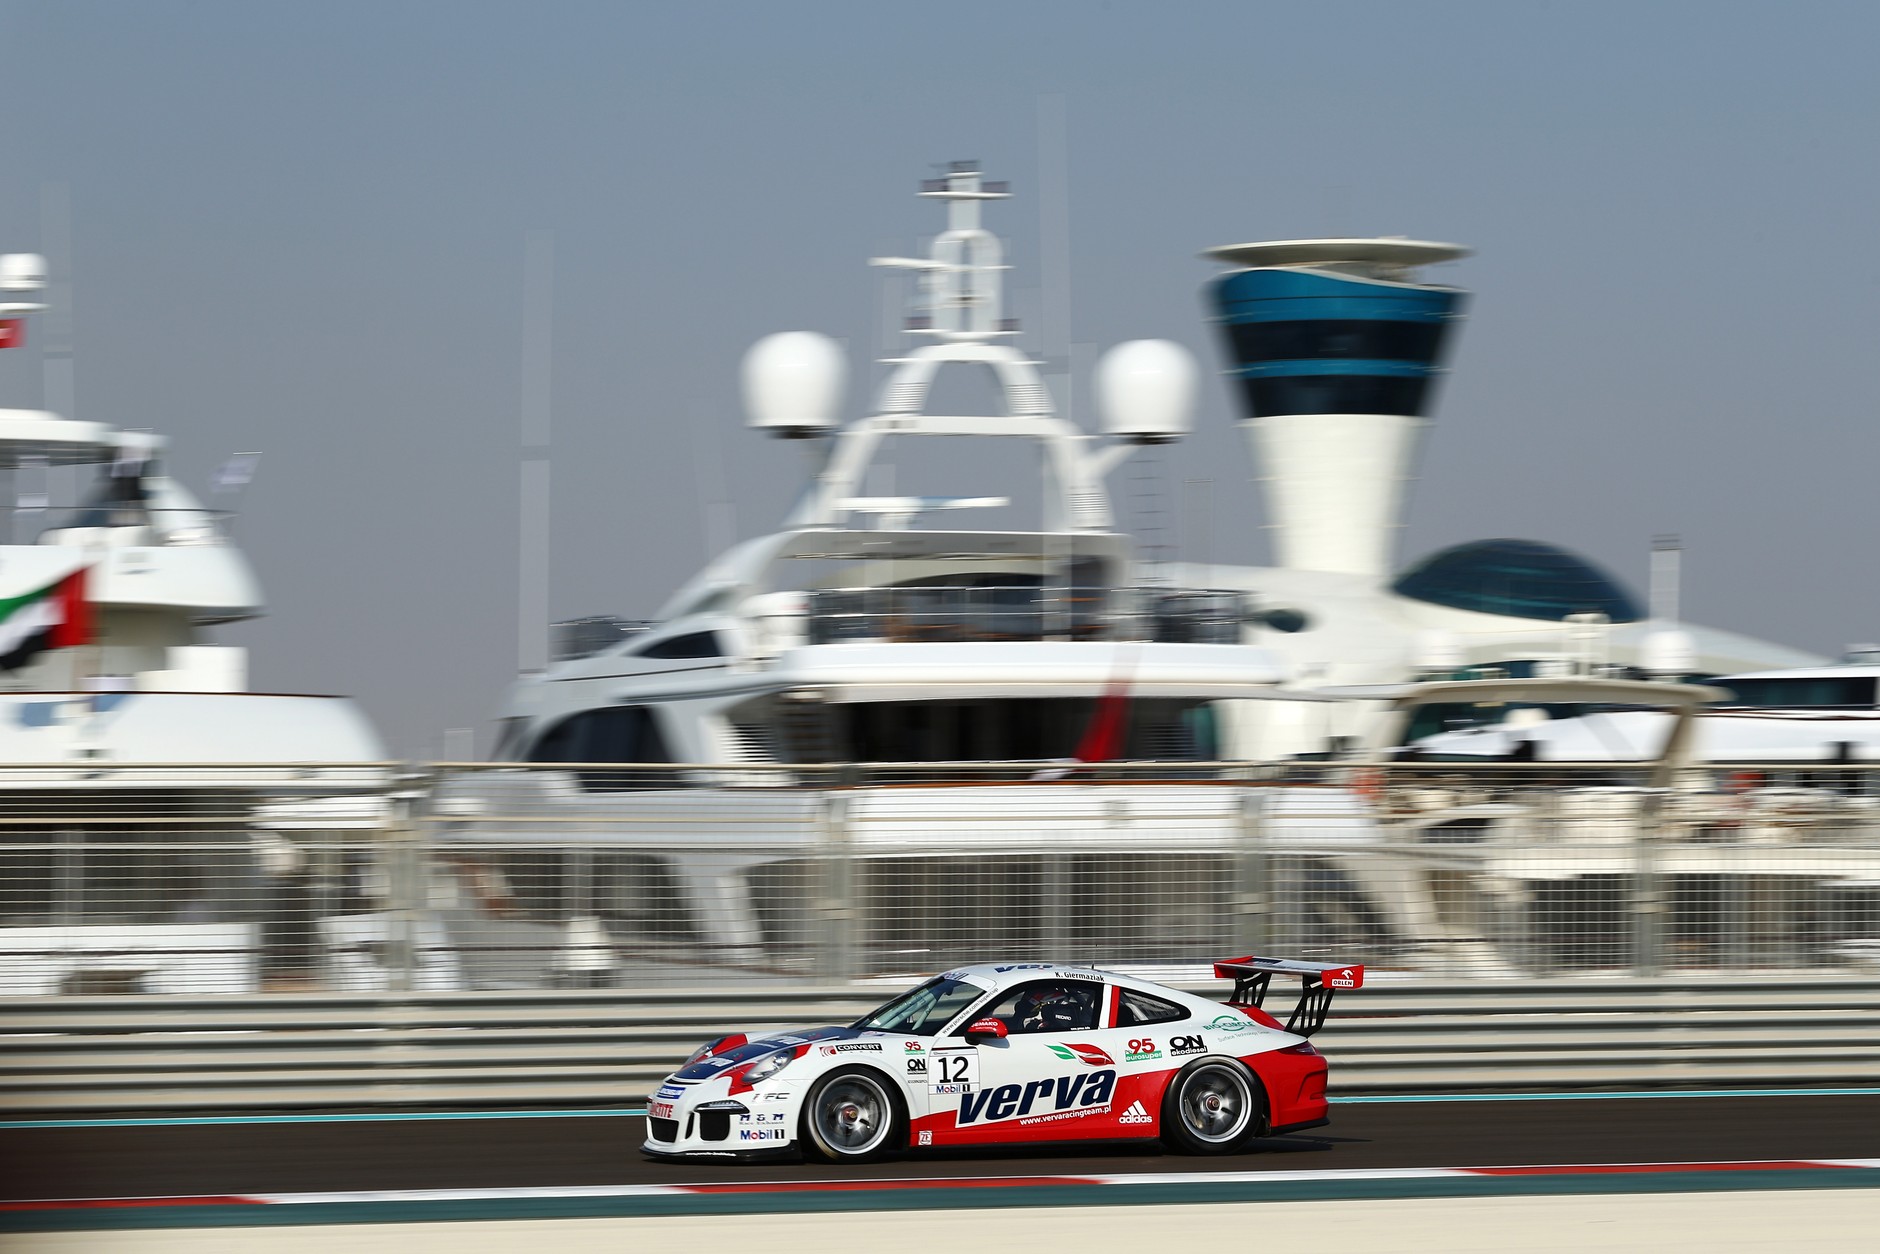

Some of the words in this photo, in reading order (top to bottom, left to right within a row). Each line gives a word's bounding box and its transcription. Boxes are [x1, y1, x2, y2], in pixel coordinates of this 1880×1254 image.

[1064, 972, 1105, 982] Giermaziak
[837, 1043, 880, 1051] CONVERT
[905, 1041, 921, 1051] 95
[1128, 1038, 1155, 1054] 95
[1169, 1035, 1205, 1049] ON
[1126, 1051, 1162, 1062] eurosuper
[1171, 1046, 1208, 1056] ekodiesel
[907, 1058, 926, 1070] ON
[938, 1056, 969, 1083] 12
[936, 1084, 961, 1093] Mobil
[958, 1069, 1116, 1125] verva
[1020, 1105, 1112, 1126] www.vervaracingteam.pl
[1119, 1114, 1152, 1124] adidas
[740, 1129, 772, 1140] Mobil
[775, 1129, 784, 1139] 1
